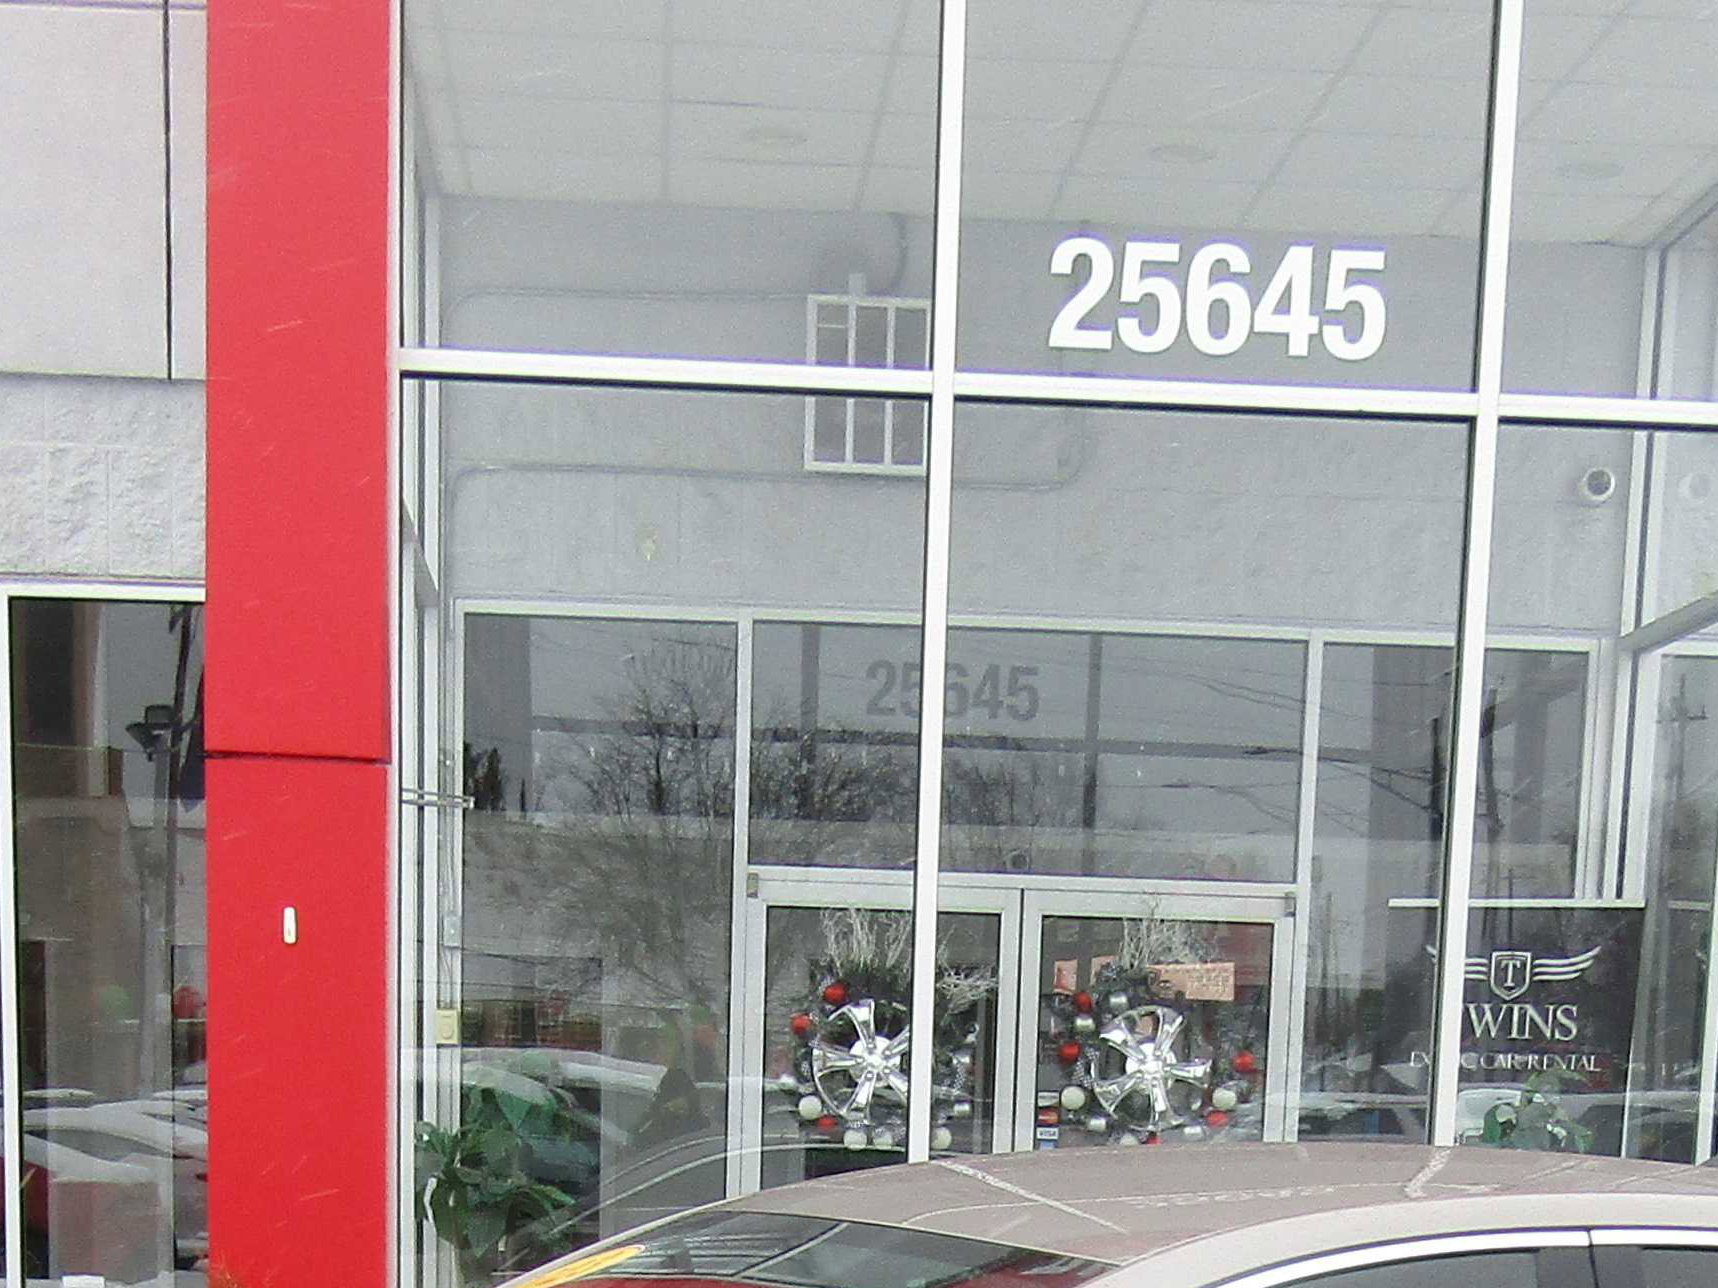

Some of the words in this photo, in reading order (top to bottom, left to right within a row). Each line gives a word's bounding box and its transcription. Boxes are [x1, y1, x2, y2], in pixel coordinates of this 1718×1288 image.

[1048, 236, 1386, 361] 25645
[1500, 958, 1522, 989] T
[1463, 1002, 1580, 1041] WINS
[1480, 1052, 1518, 1071] CAR
[1526, 1053, 1602, 1072] RENTAL
